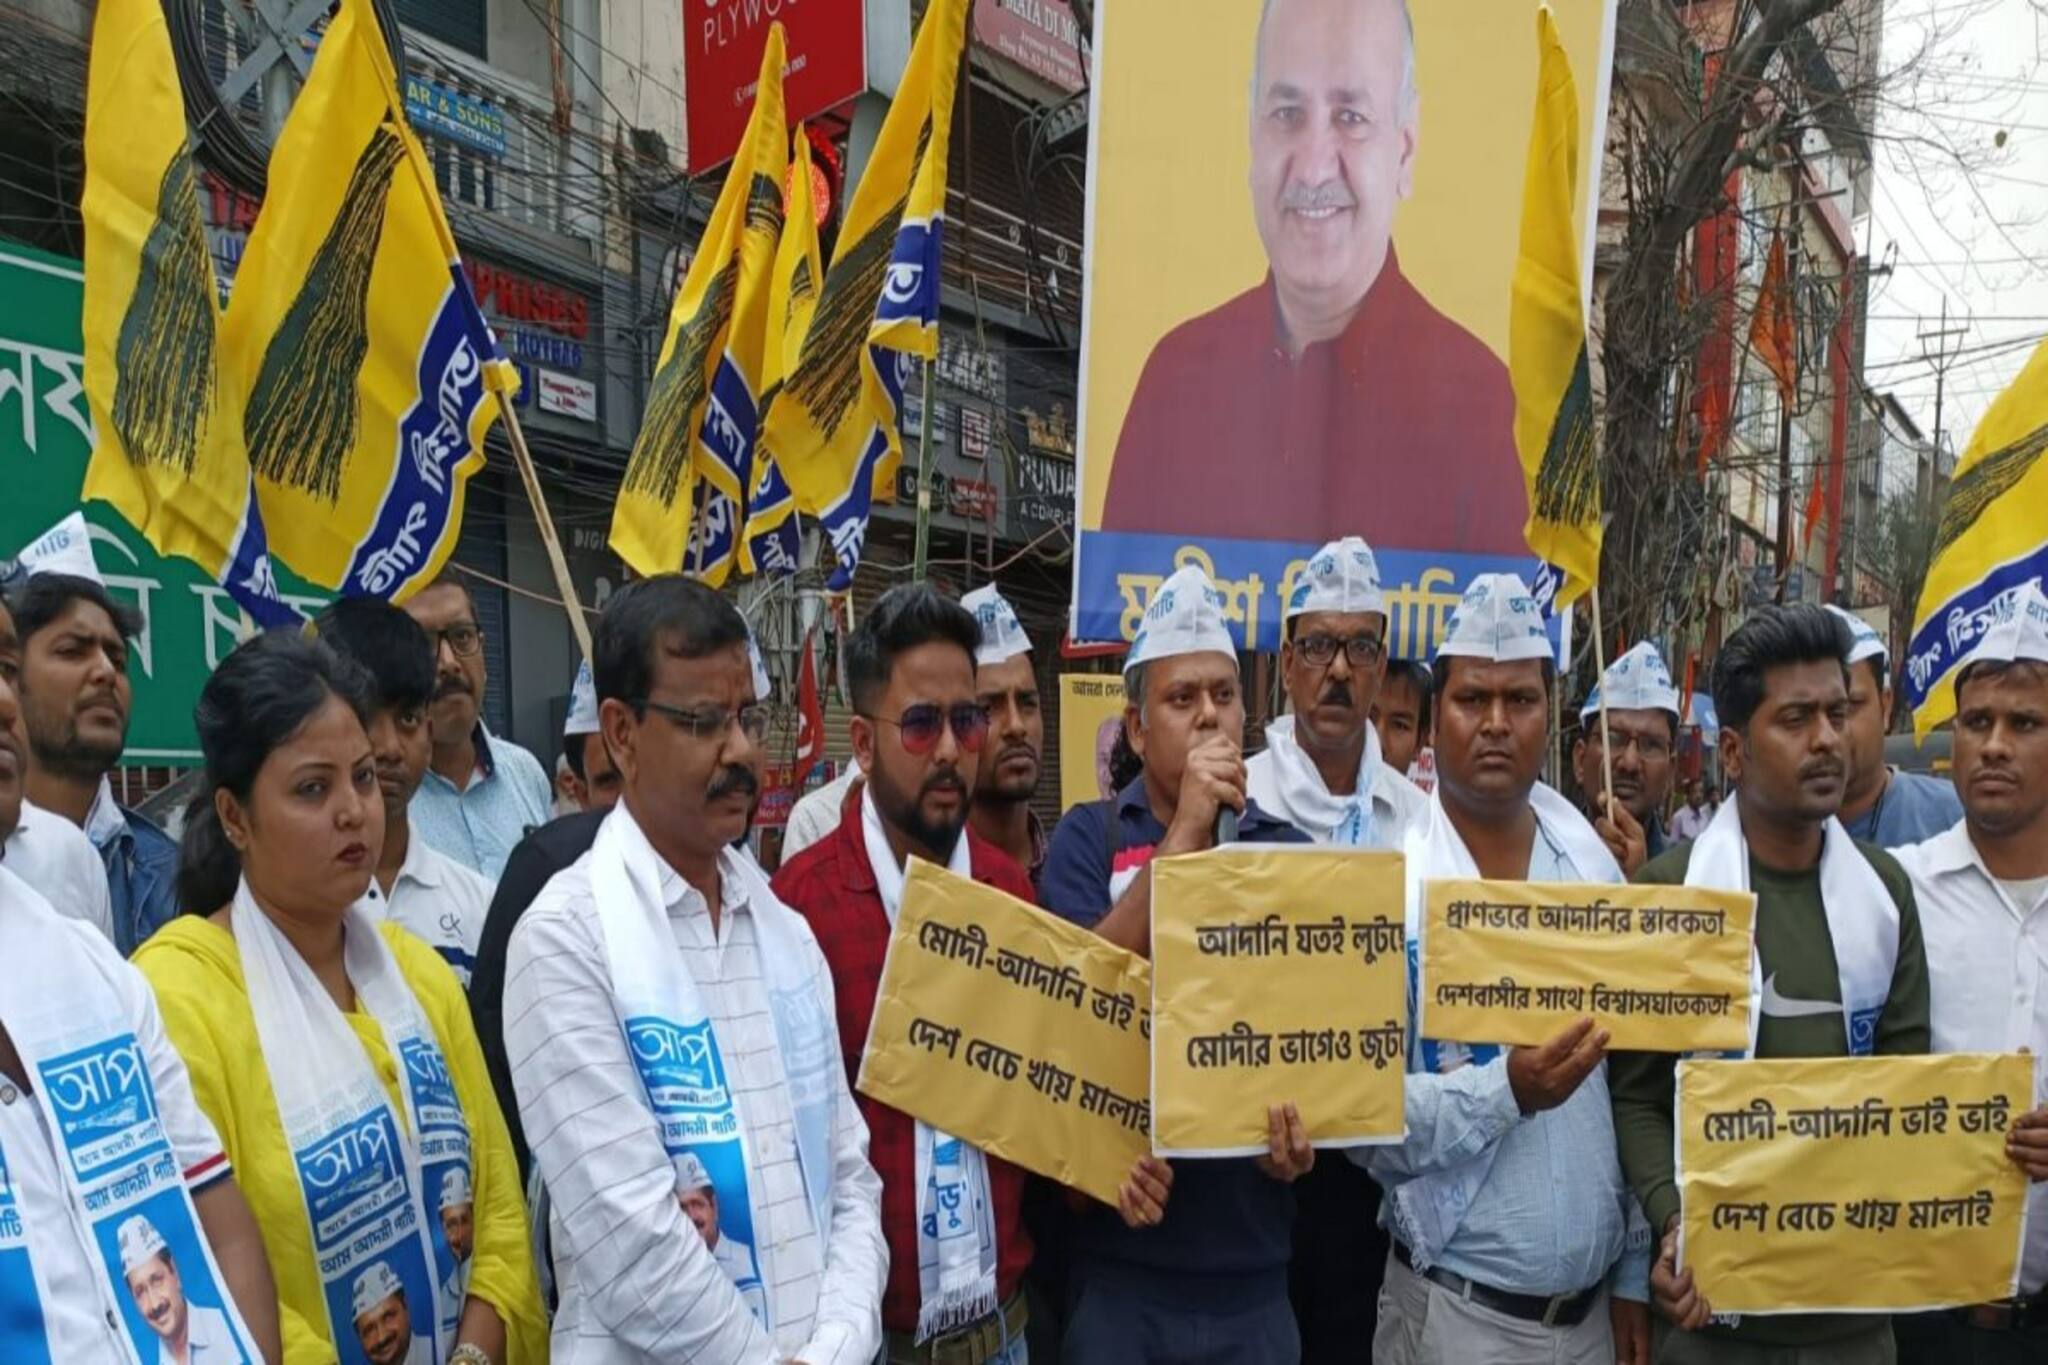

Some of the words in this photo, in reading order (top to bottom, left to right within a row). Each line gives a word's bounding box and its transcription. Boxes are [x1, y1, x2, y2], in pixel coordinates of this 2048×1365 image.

[456, 106, 502, 135] SONS
[1196, 914, 1288, 958] আদানি
[1295, 914, 1347, 956] যতই
[1446, 900, 1531, 930] প্রাণভরে
[1536, 898, 1633, 934] আদানির
[1639, 905, 1726, 937] স্তাবকতা
[918, 920, 1086, 1010] মোদী-আদানি
[1091, 985, 1138, 1036] ভাই
[1435, 977, 1532, 1010] দেশবাসীর
[1536, 986, 1584, 1011] সাথে
[1590, 983, 1731, 1018] বিশ্বাসঘাতকতা
[909, 1015, 961, 1060] দেশ
[964, 1036, 1024, 1083] বেচে
[1026, 1056, 1076, 1105] খায়
[1187, 1021, 1271, 1071] মোদীর
[1279, 1026, 1352, 1066] ভাগেও
[43, 1042, 156, 1119] আপ
[1703, 1098, 1894, 1141] মোদী-আদানি
[1900, 1096, 1951, 1135] ভাই
[1959, 1094, 2011, 1133] ভাই
[301, 1112, 398, 1188] আপ
[1712, 1201, 1770, 1232] দেশ
[1776, 1203, 1837, 1232] বেচে
[1845, 1199, 1902, 1233] খায়
[1907, 1190, 1995, 1230] মালাই
